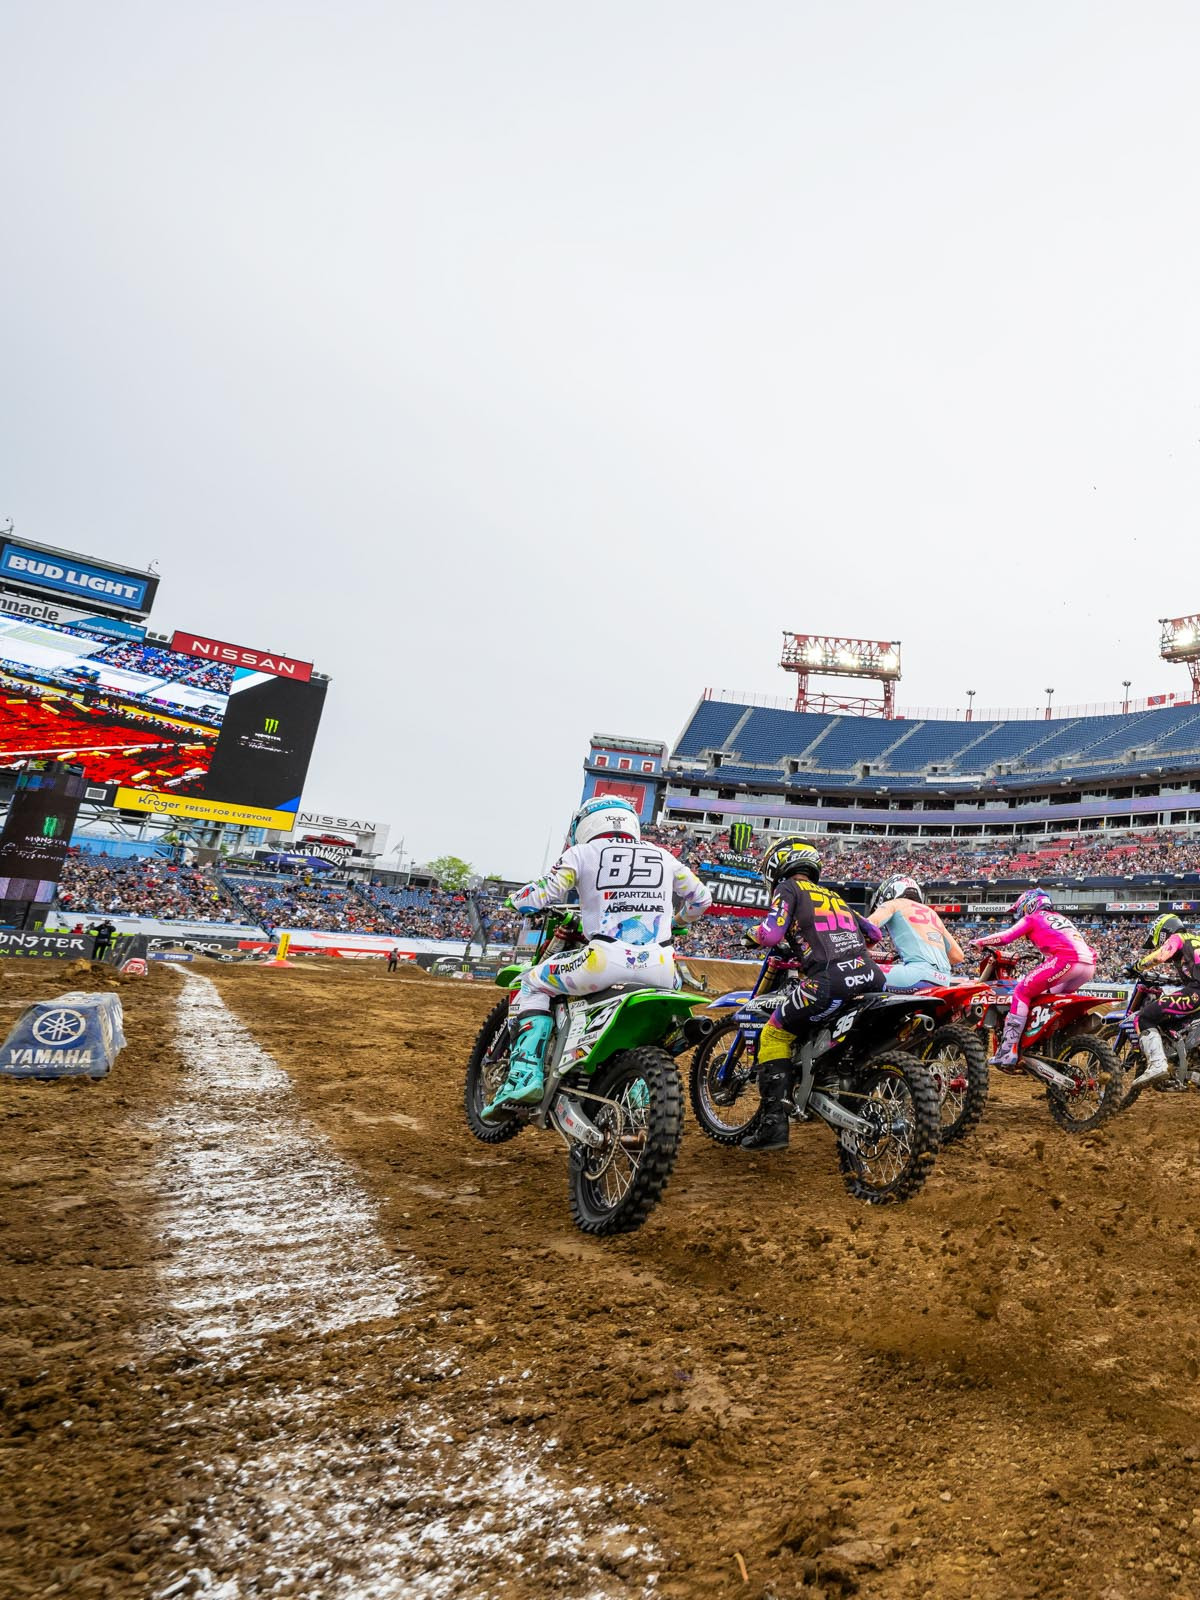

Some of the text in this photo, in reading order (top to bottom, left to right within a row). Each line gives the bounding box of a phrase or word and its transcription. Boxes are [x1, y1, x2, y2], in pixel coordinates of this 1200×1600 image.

[8, 555, 138, 599] BUD LIGHT
[192, 640, 296, 674] NISSAN
[138, 794, 273, 822] Kroger FRESH FOR EVERYONE
[300, 813, 376, 831] NISSAN
[720, 852, 757, 865] MONSTER
[596, 846, 664, 891] 85
[619, 891, 663, 899] PARTZILLA
[706, 881, 770, 907] FINISH
[605, 904, 664, 913] ADRENALINE
[809, 892, 858, 932] 36
[1172, 902, 1191, 910] FedEx
[934, 972, 947, 981] FOX
[1048, 963, 1072, 983] GASGAS
[971, 996, 1013, 1004] GASGA
[1159, 996, 1194, 1010] FXR
[832, 1010, 858, 1038] 36
[1031, 1006, 1050, 1028] 34
[10, 1049, 92, 1064] YAMAHA
